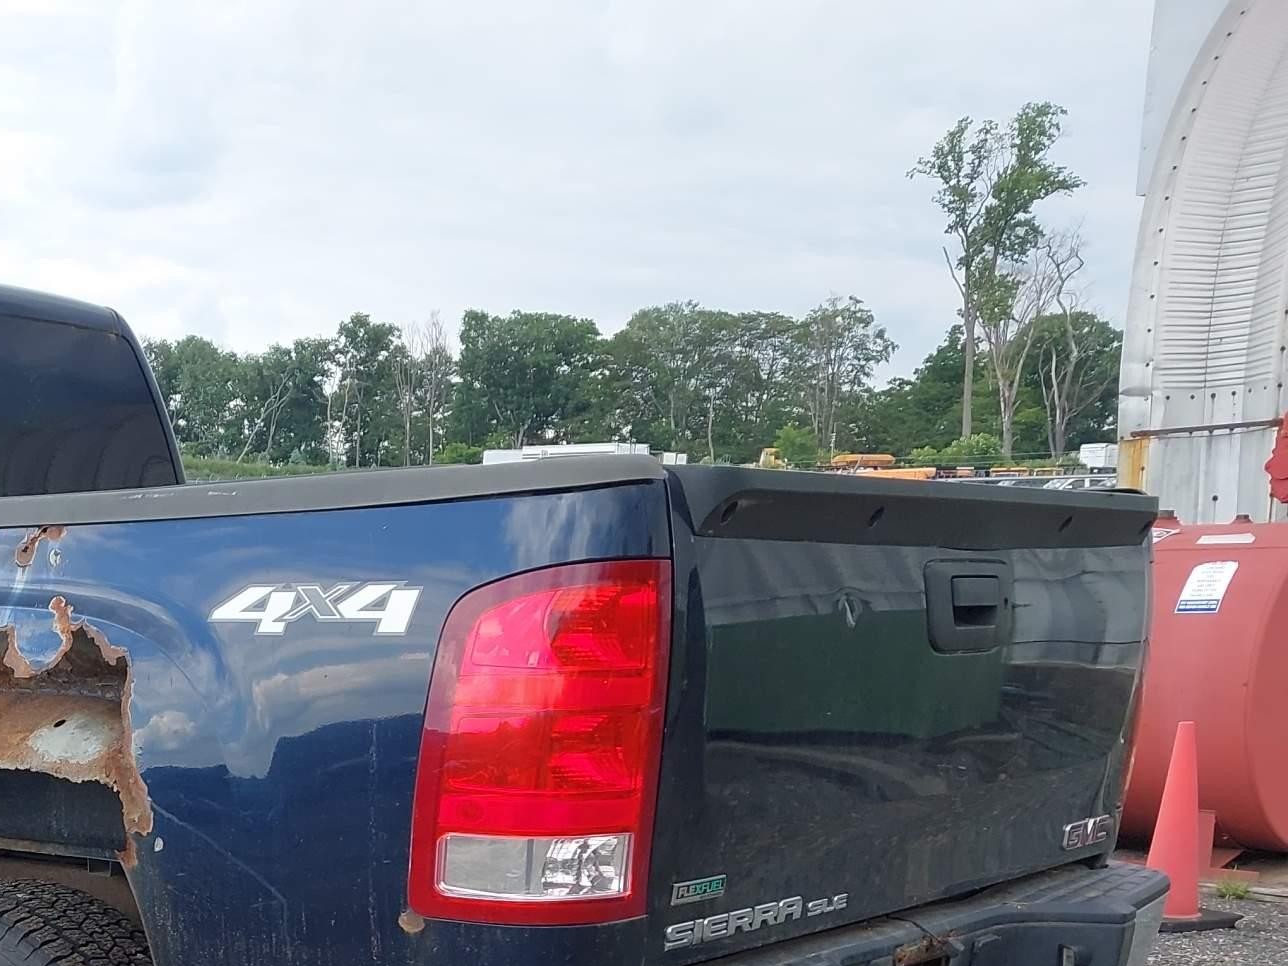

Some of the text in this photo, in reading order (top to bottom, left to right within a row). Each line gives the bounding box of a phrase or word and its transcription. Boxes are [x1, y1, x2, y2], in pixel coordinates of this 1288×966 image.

[1062, 814, 1112, 850] GMC
[678, 879, 725, 899] FLEXFUEL
[664, 893, 849, 951] SIERRA SLE
